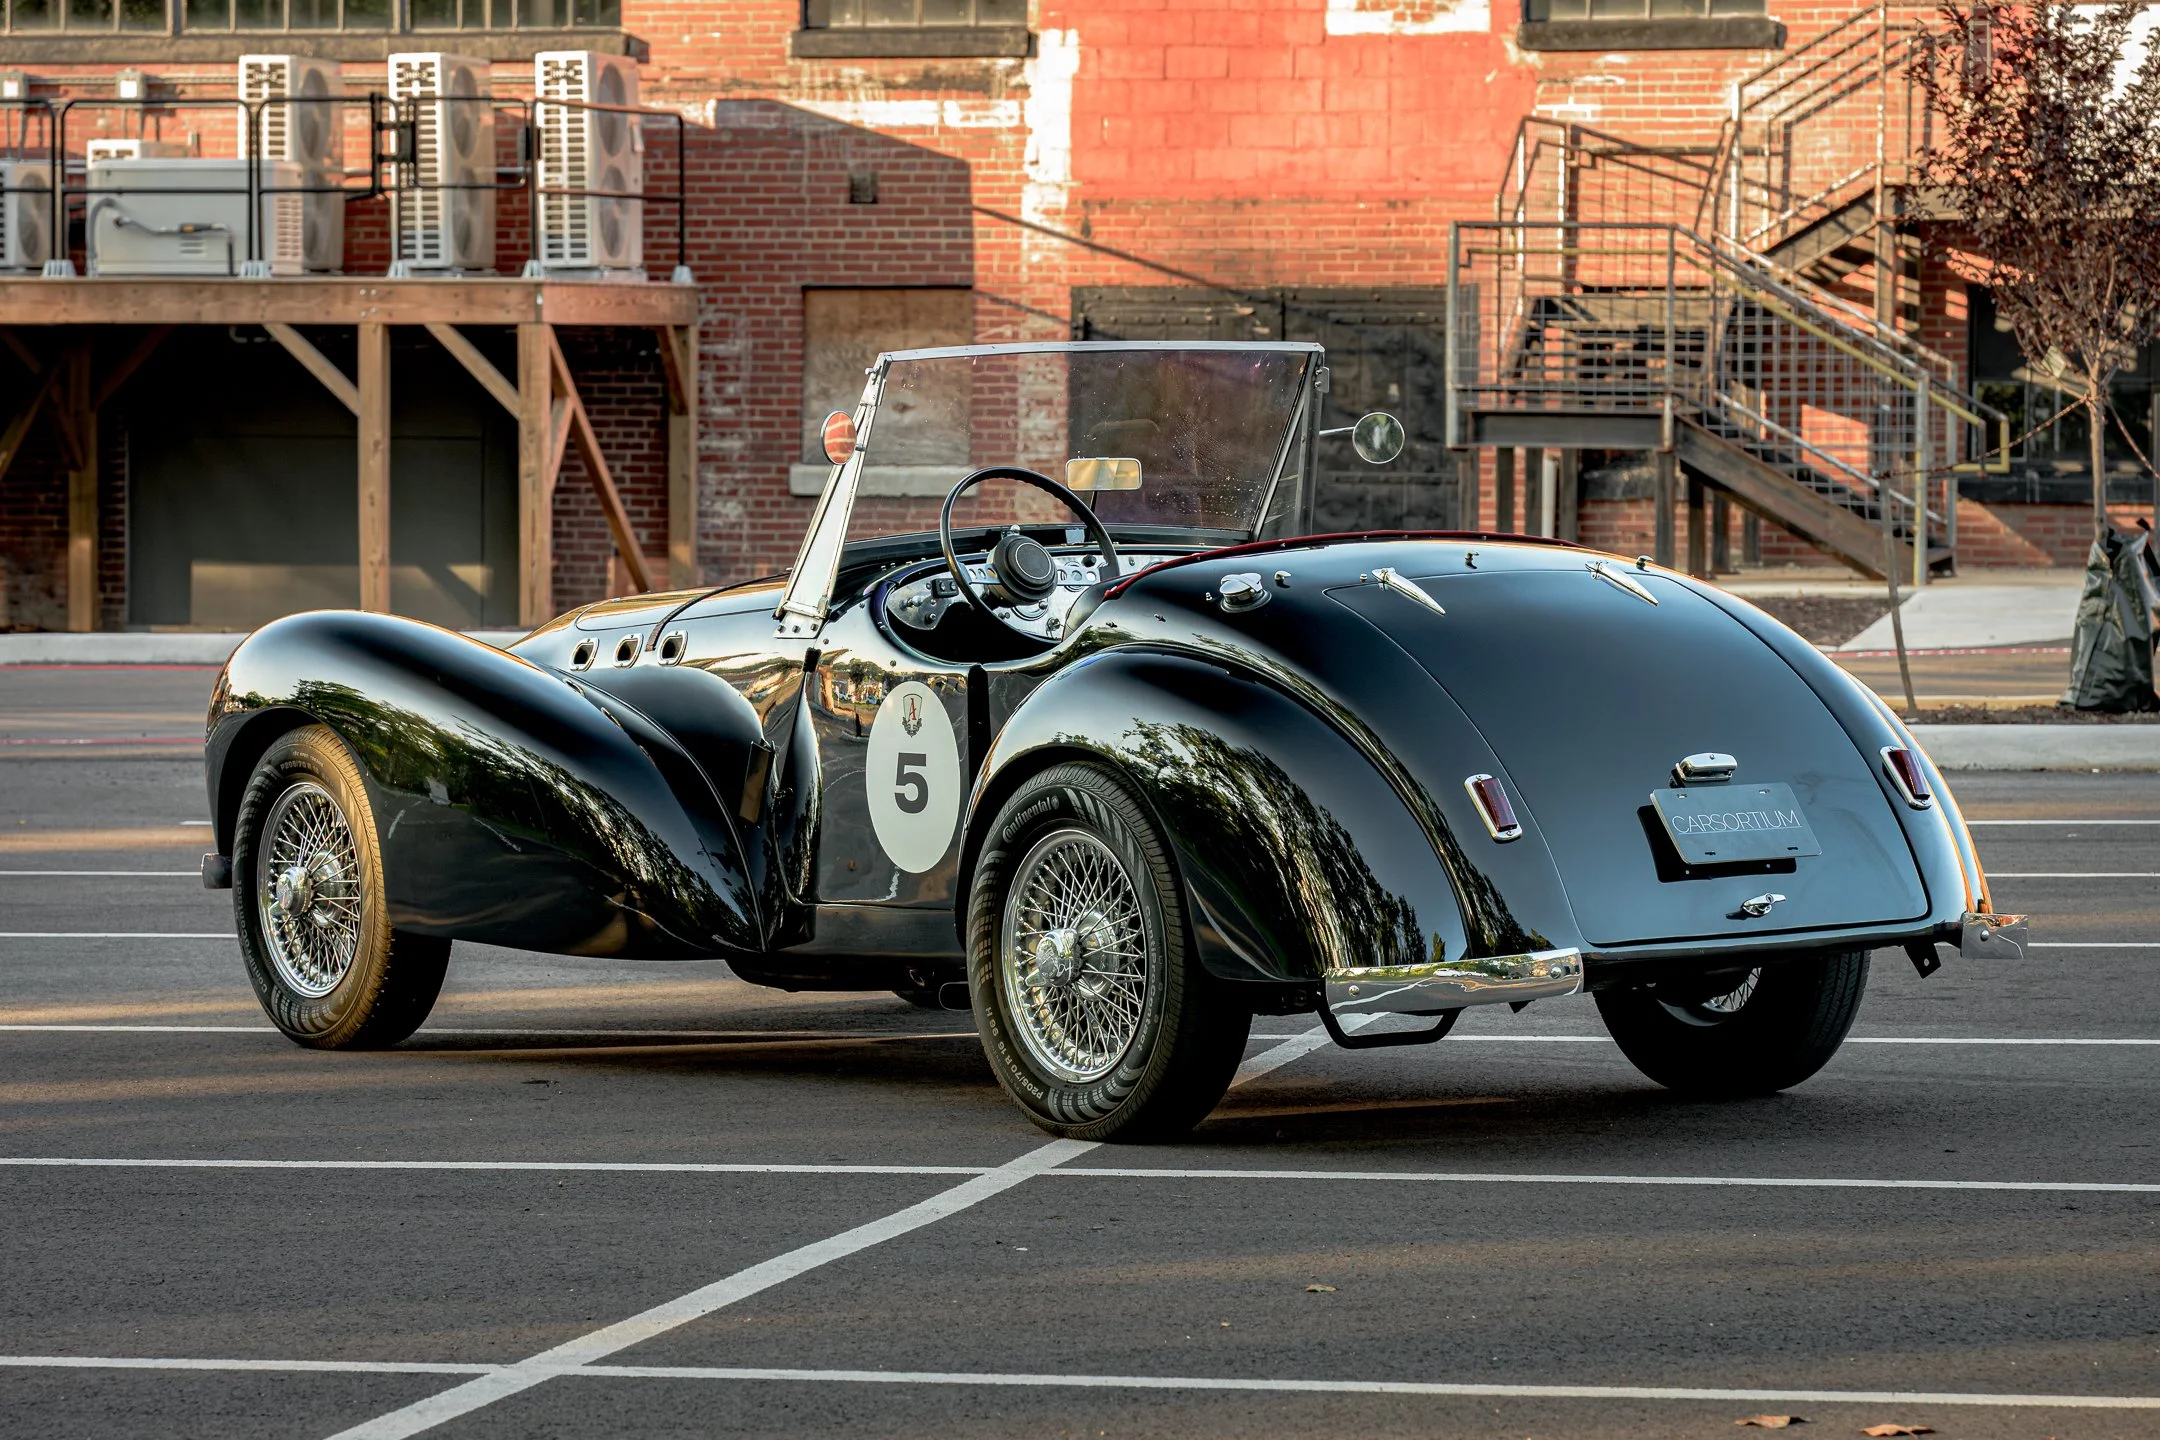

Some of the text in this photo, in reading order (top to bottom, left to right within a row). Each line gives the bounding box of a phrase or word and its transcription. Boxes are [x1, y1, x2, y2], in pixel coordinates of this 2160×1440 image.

[894, 752, 929, 815] 5
[1002, 797, 1052, 844] Continental
[1672, 810, 1801, 833] CARSORTIUM
[236, 879, 268, 994] ContiProContact
[1137, 905, 1157, 1051] ContiProContact
[985, 1007, 993, 1017] H
[997, 1041, 1006, 1055] 16
[1005, 1055, 1013, 1066] R
[1010, 1064, 1044, 1099] P205/70
